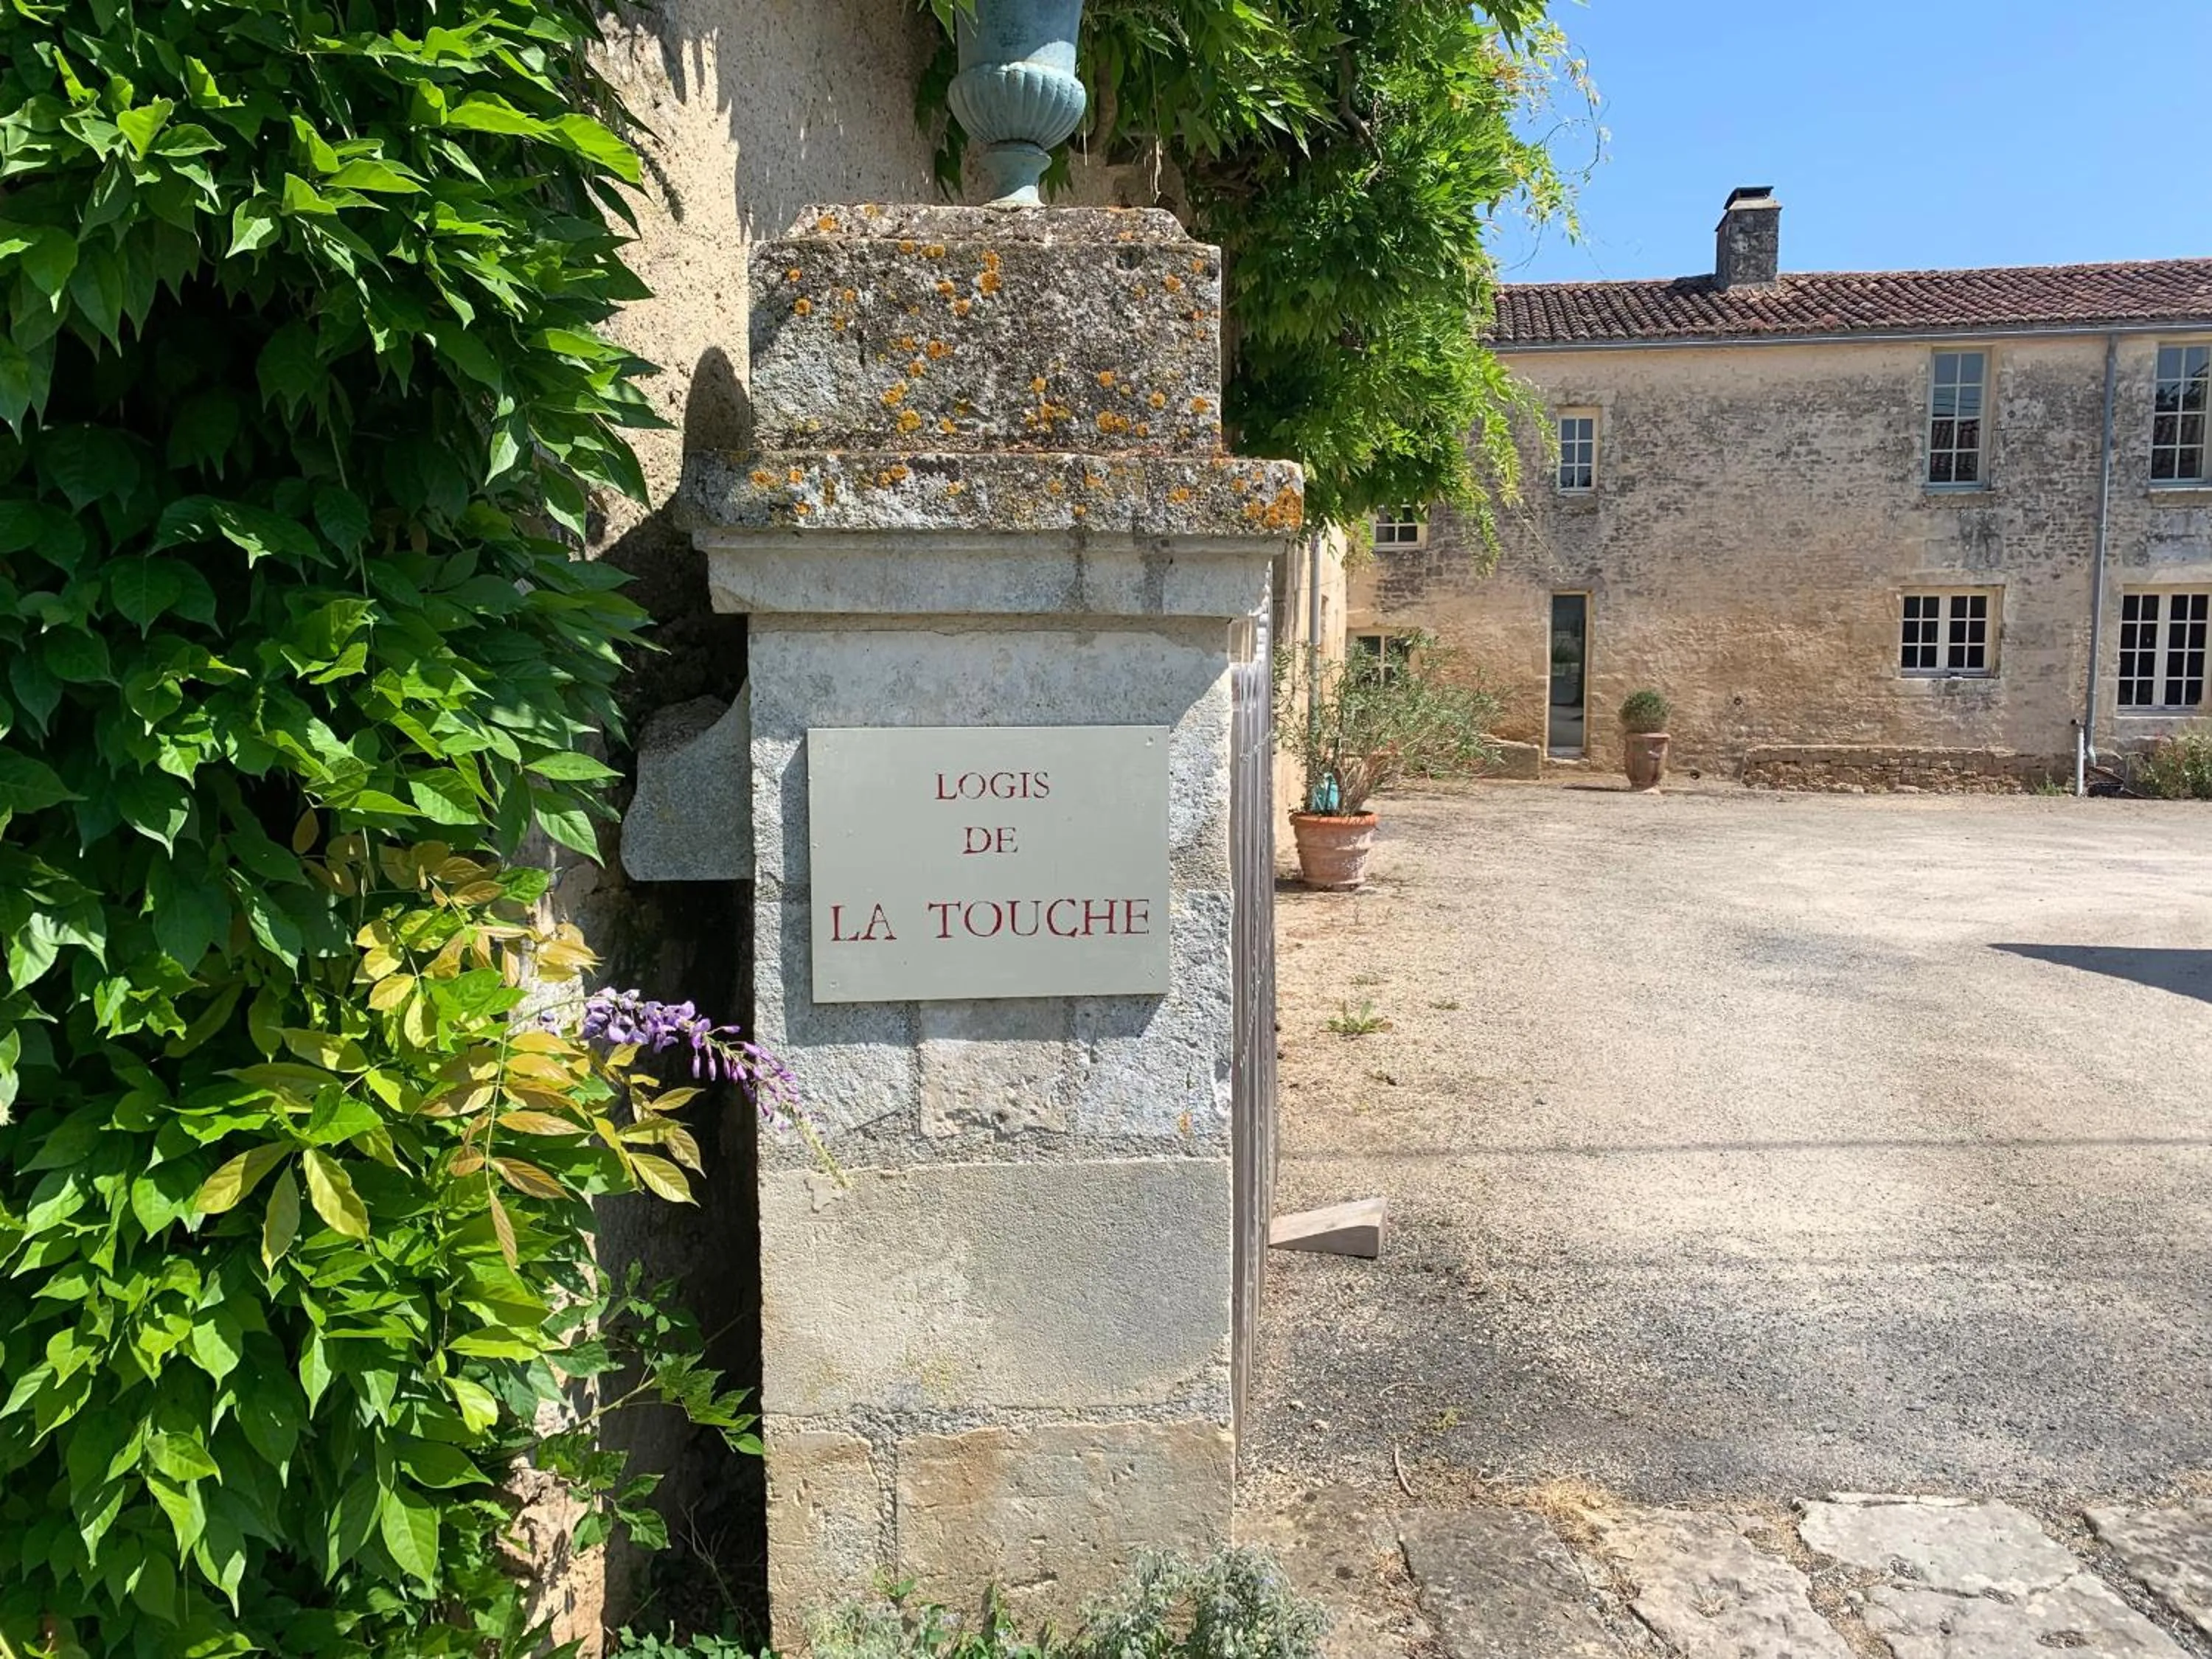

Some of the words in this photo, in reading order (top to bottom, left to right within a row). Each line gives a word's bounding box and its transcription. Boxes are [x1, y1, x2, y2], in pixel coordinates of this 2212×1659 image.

[935, 771, 1051, 800] LOGIS
[962, 827, 1018, 855] DE
[831, 903, 897, 942] LA
[928, 898, 1150, 939] TOUCHE
